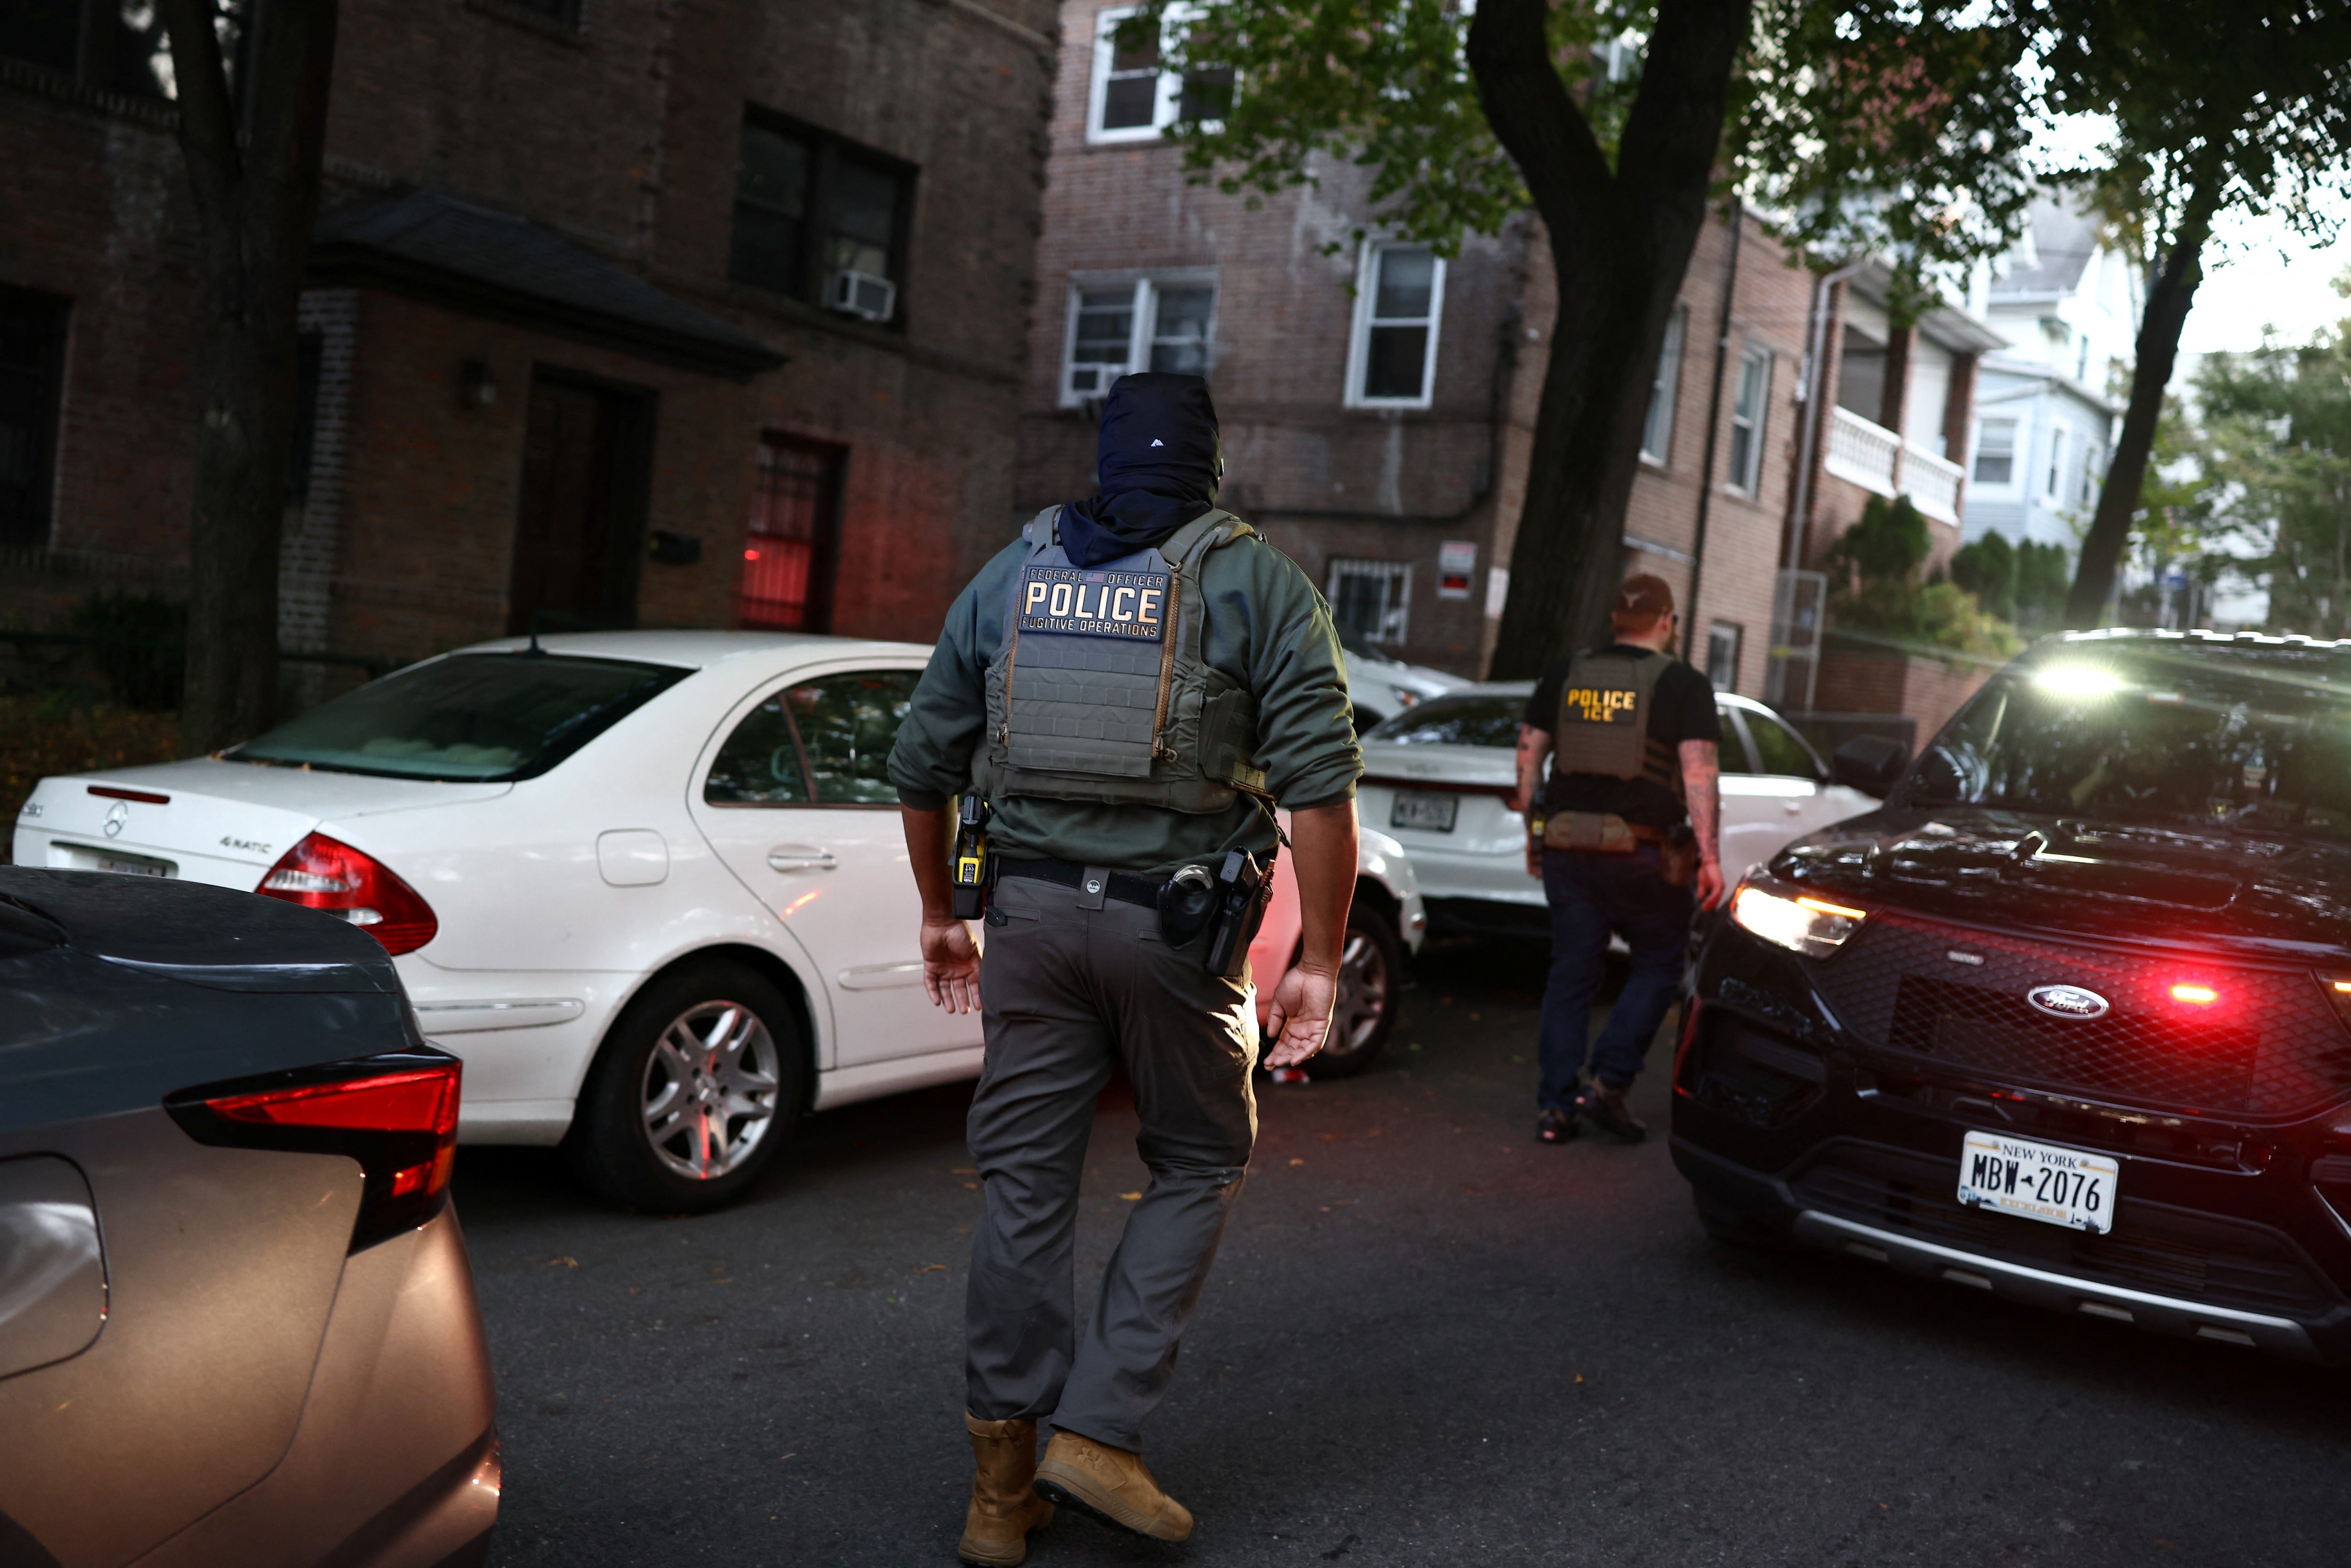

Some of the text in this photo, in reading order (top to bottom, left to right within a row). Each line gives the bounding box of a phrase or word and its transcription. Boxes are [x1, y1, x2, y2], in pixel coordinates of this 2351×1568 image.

[1030, 569, 1163, 587] FEDERAL OFFICER
[1025, 582, 1161, 623] POLICE
[1022, 617, 1157, 637] FUGITIVE OPERATIONS
[1568, 689, 1636, 710] POLICE
[1583, 705, 1614, 722] ICE
[2044, 991, 2090, 1013] Ford
[2003, 1143, 2077, 1169] NEW YORK
[1972, 1154, 2100, 1211] MBW 2076
